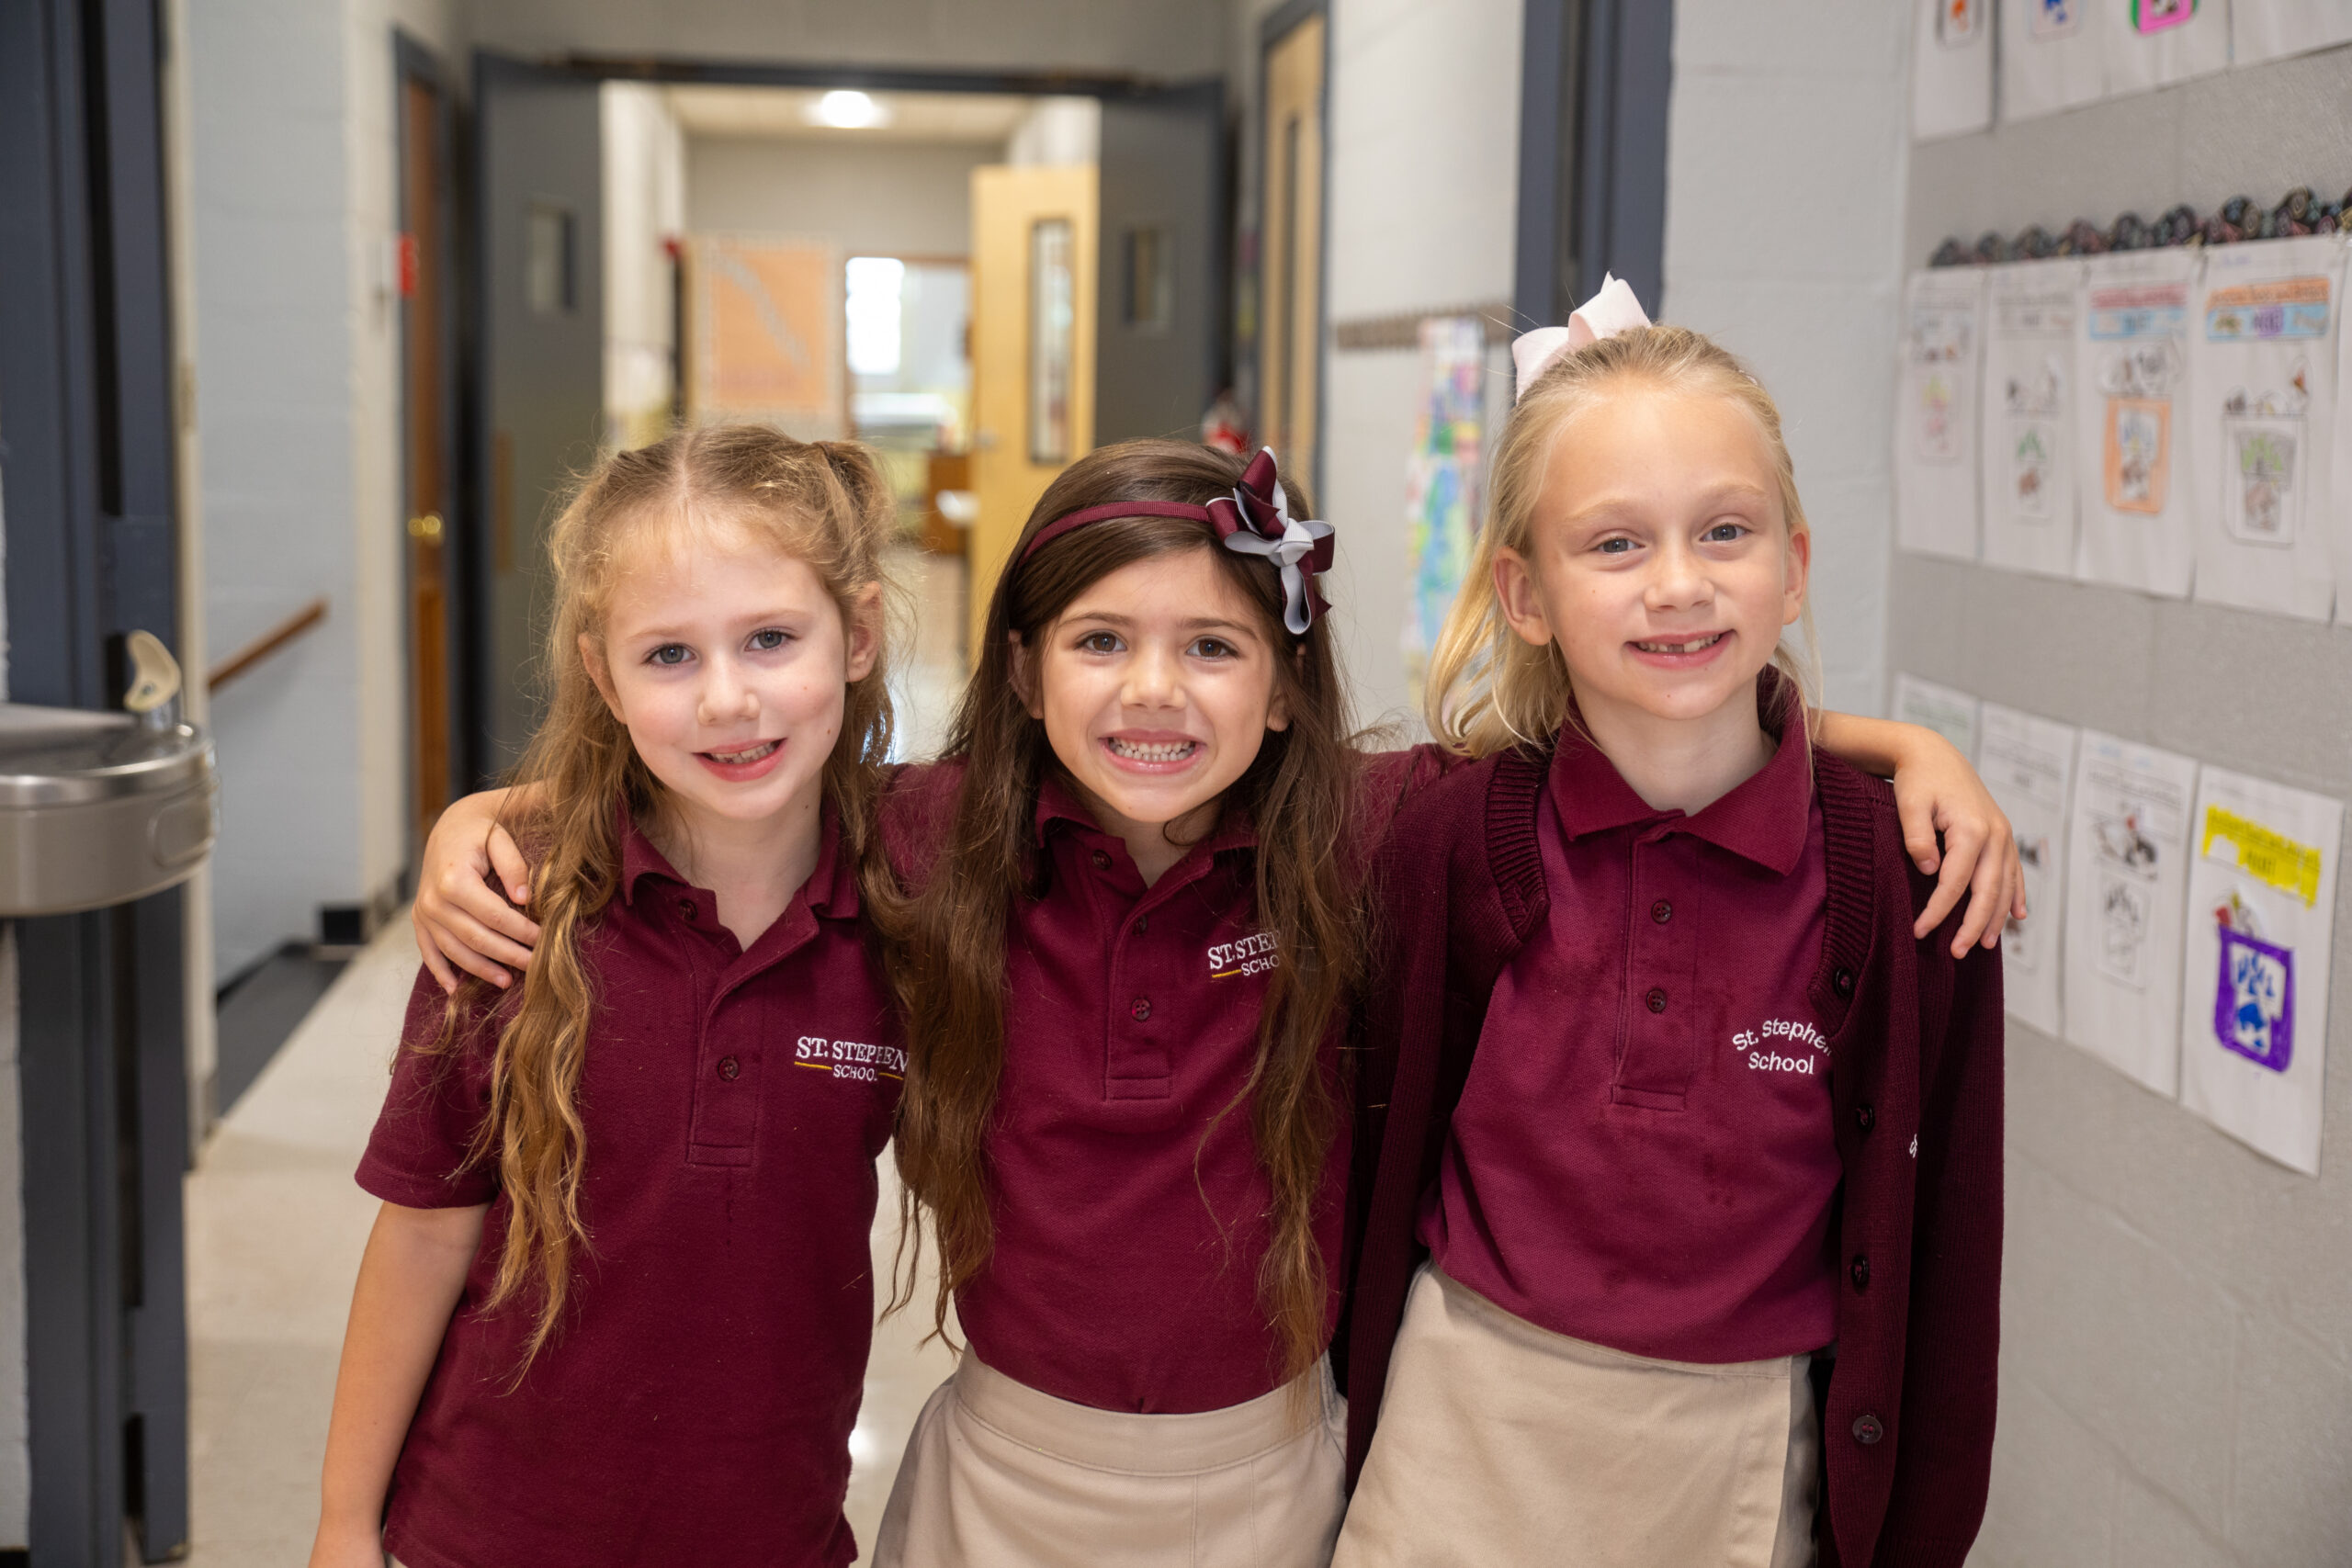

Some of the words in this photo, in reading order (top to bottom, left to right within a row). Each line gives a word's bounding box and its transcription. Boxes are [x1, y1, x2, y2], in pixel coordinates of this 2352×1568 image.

[1208, 943, 1235, 970] ST.
[1240, 954, 1280, 976] SCHO
[796, 1036, 829, 1059] ST.
[1747, 1052, 1814, 1075] School
